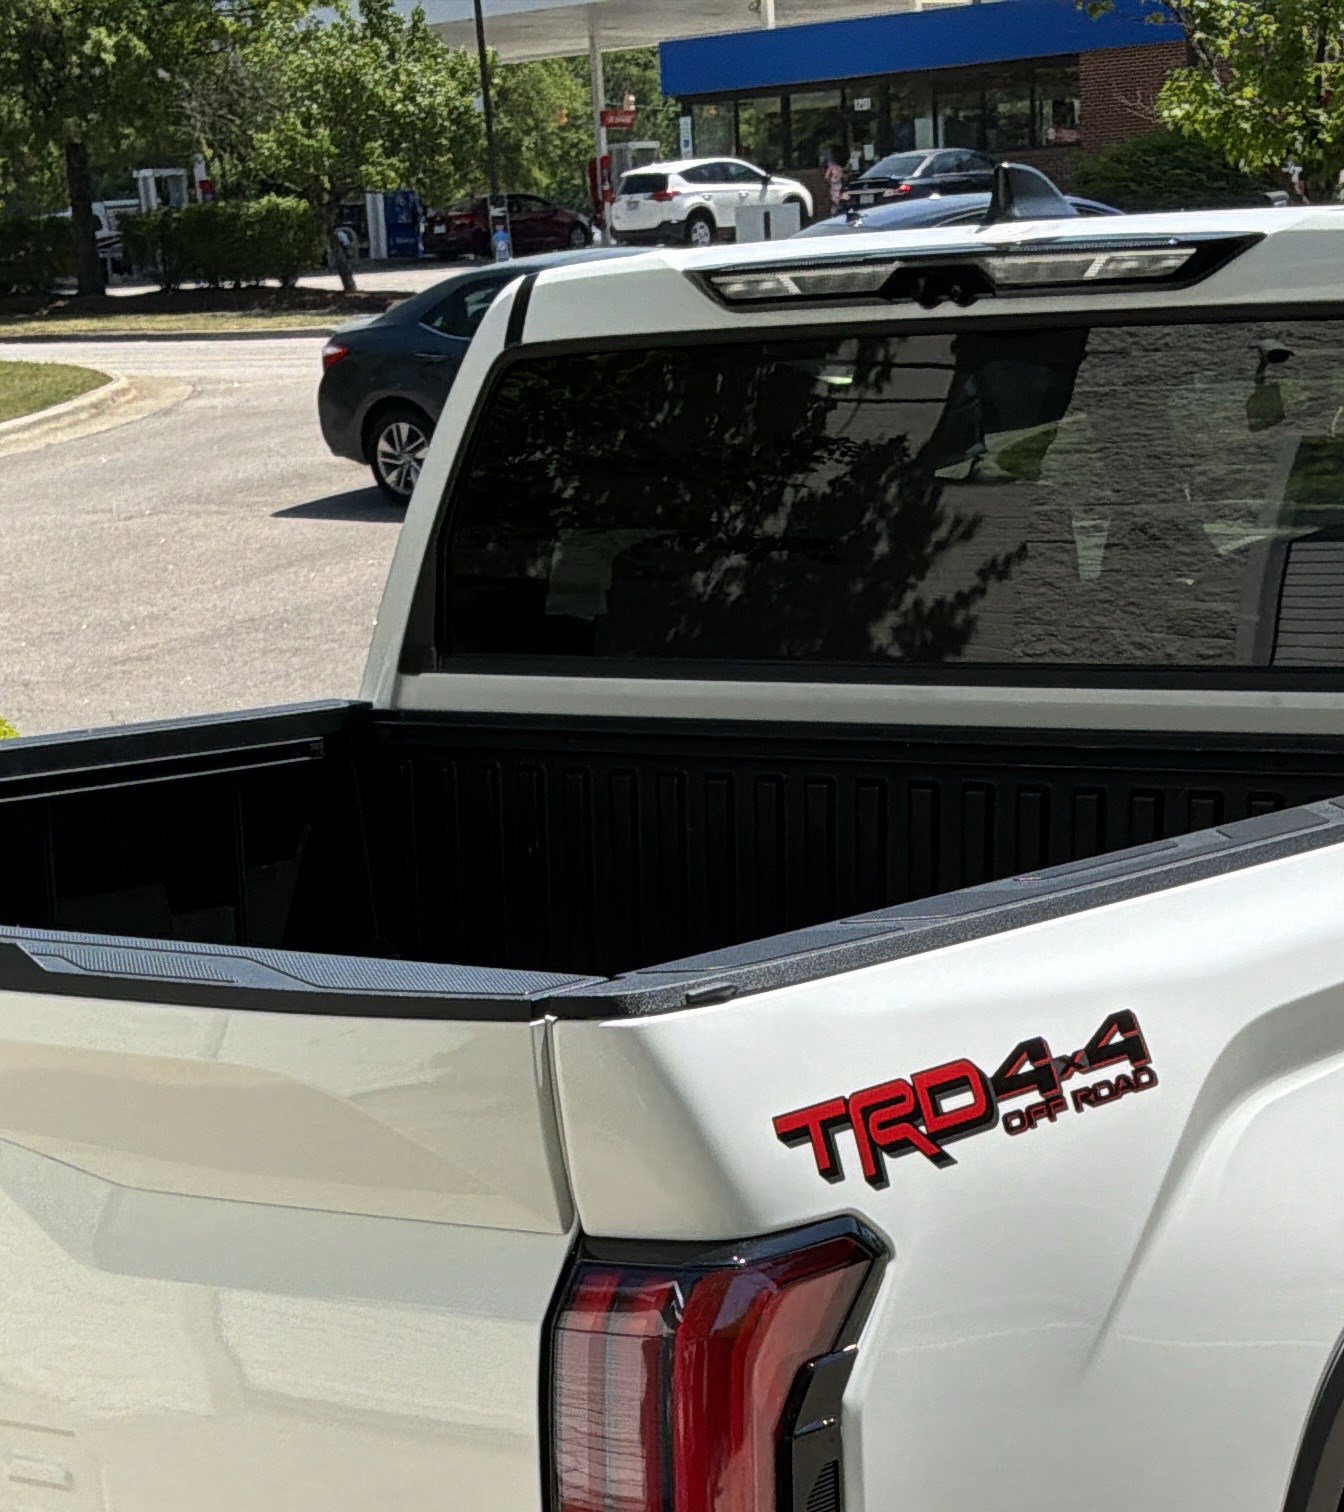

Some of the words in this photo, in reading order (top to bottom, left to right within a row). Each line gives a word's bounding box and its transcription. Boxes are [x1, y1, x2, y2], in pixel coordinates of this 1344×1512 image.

[772, 1058, 999, 1191] TRD
[1002, 1094, 1068, 1137] OFF
[1070, 1064, 1159, 1114] ROAD
